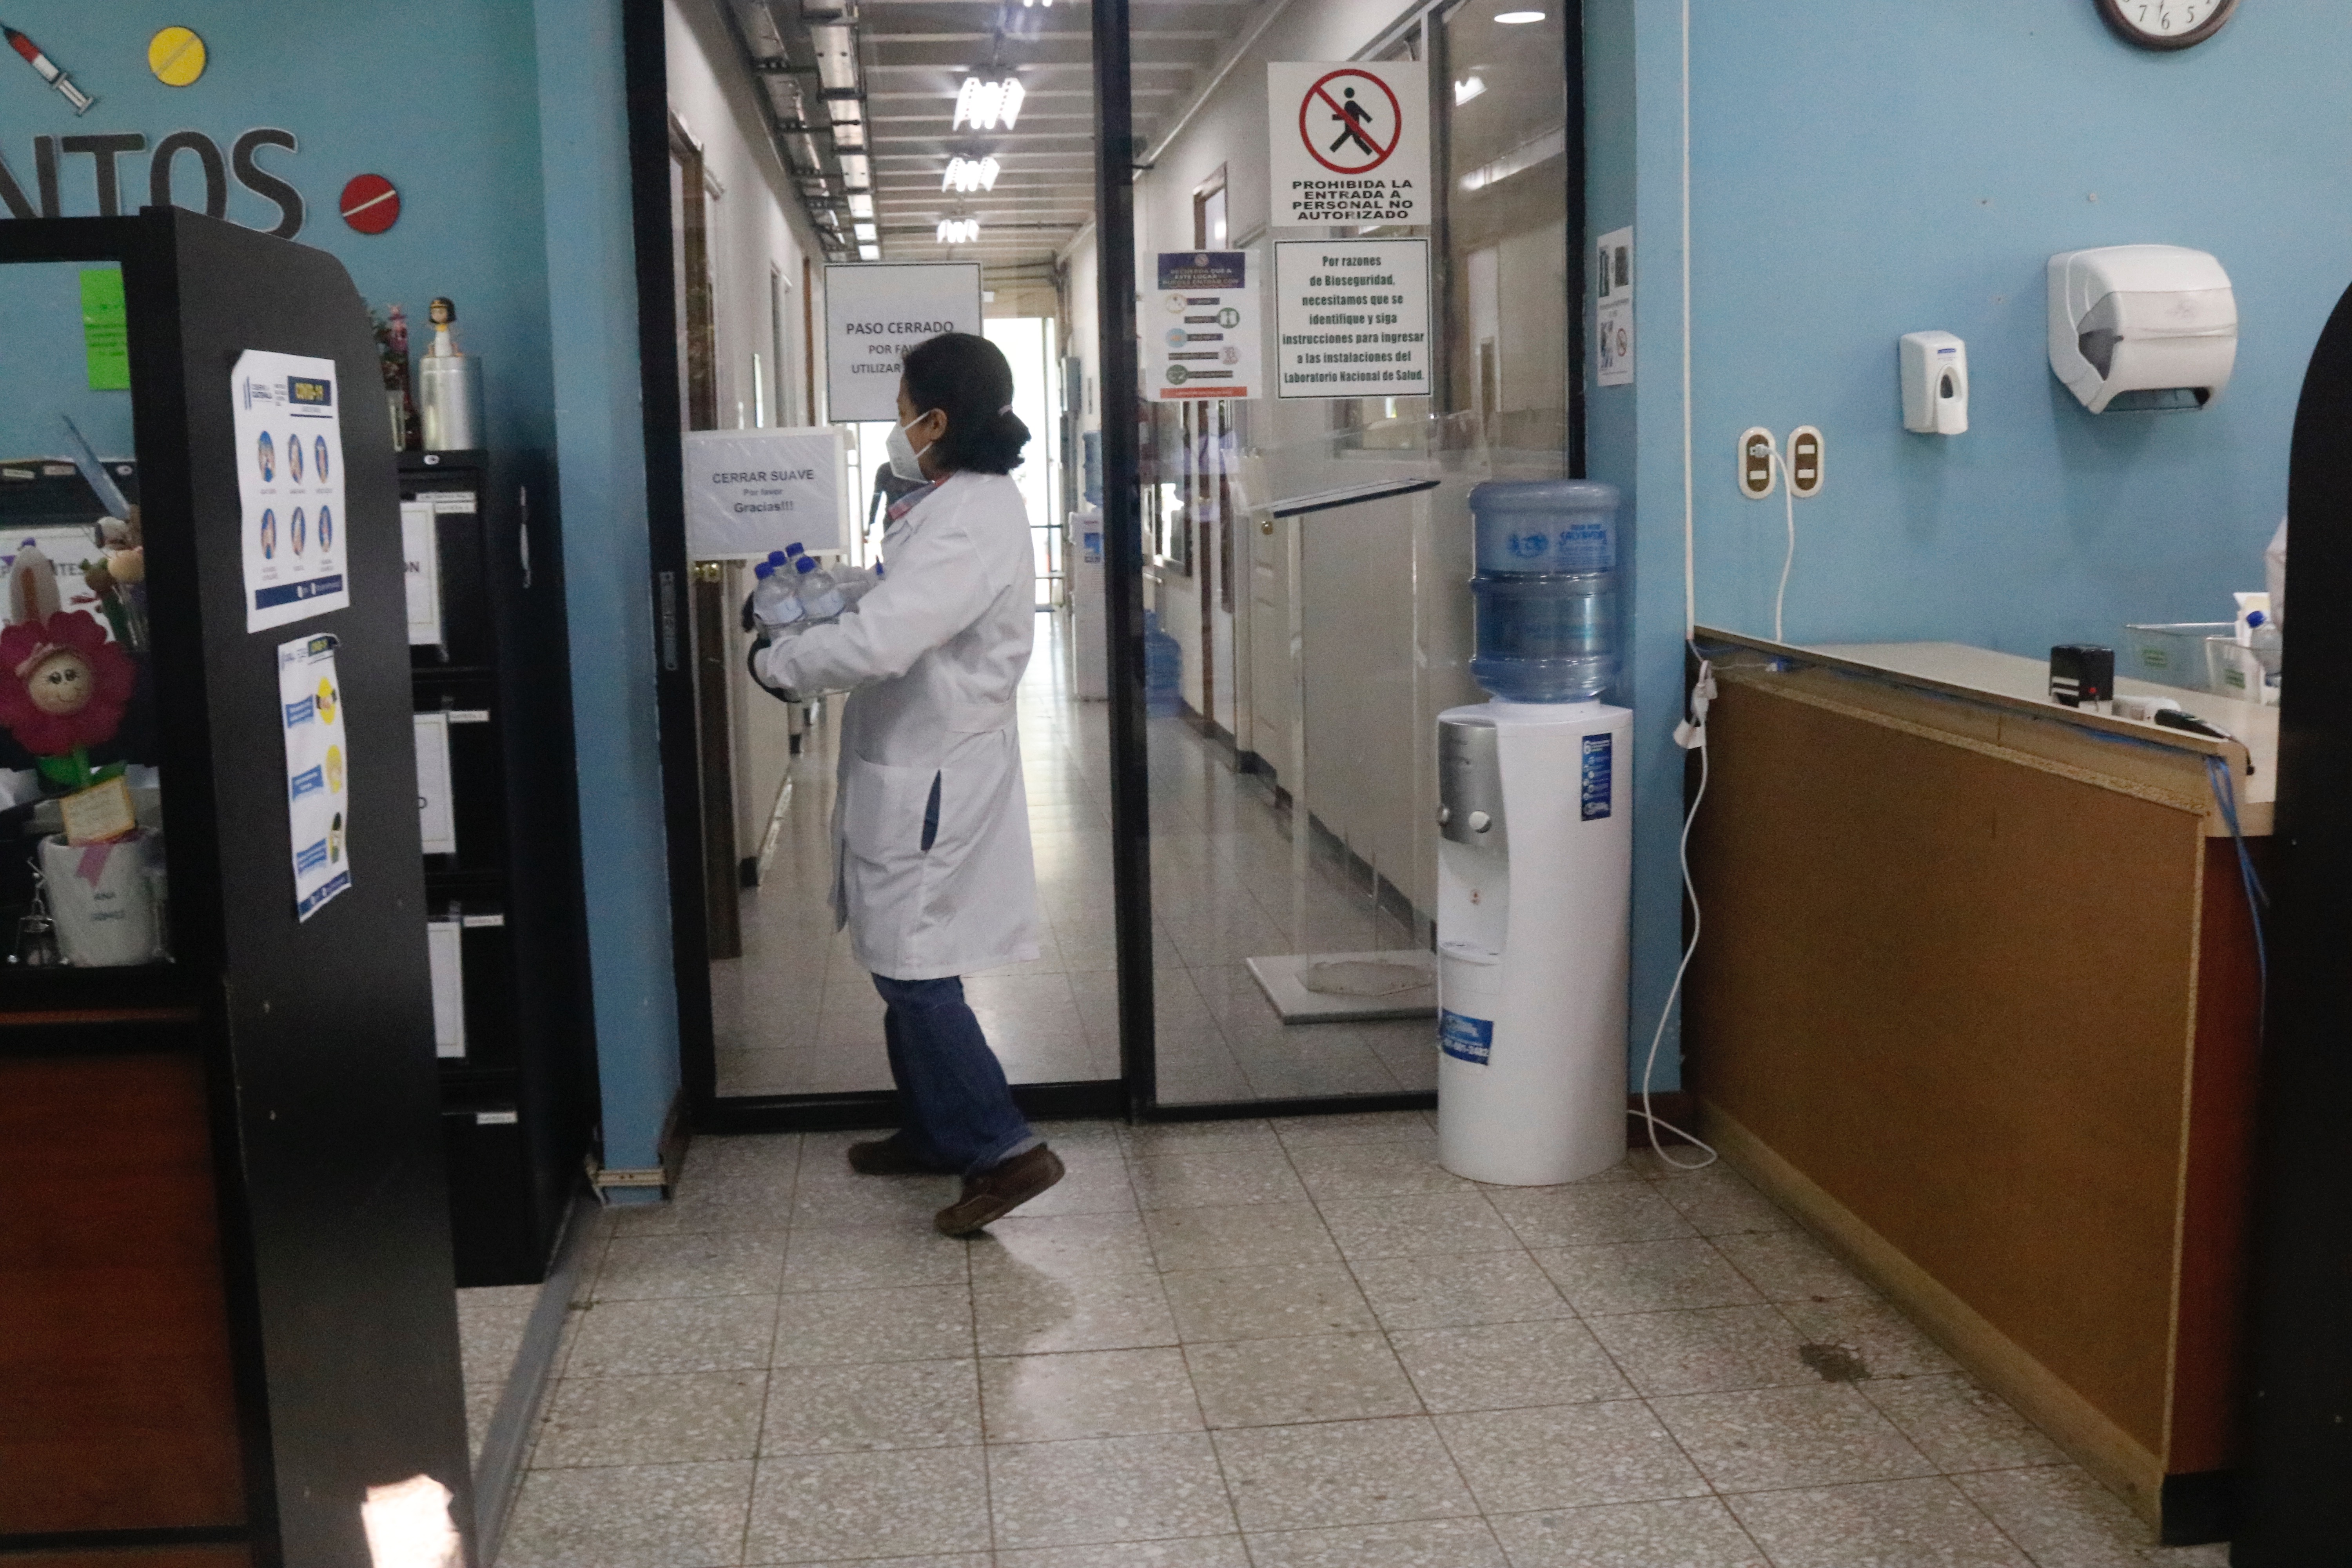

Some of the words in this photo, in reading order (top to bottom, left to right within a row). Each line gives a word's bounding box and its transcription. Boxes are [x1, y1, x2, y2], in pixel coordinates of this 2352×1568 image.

[2139, 5, 2147, 22] 7
[2186, 5, 2194, 24] 5
[2161, 12, 2170, 30] 6
[1292, 180, 1385, 189] PROHIBIDA
[1392, 180, 1412, 188] LA
[1305, 191, 1384, 200] ENTRADA
[1390, 190, 1401, 198] A
[1293, 201, 1383, 210] PERSONAL
[1389, 200, 1413, 209] NO
[1298, 210, 1408, 220] AUTORIZADO
[1322, 256, 1339, 267] Por
[1342, 257, 1381, 266] razones
[1310, 276, 1322, 287] de
[1302, 295, 1368, 306] necesitamos
[1370, 296, 1389, 305] que
[1392, 295, 1403, 304] se
[1309, 314, 1365, 325] identifique
[1368, 315, 1373, 325] y
[1376, 313, 1397, 325] siga
[846, 323, 883, 334] PASO
[888, 321, 953, 334] CERRADO
[1283, 334, 1353, 345] instrucciones
[1356, 334, 1379, 344] para
[1381, 333, 1424, 344] ingresar
[869, 345, 892, 354] POR
[1297, 355, 1303, 364] a
[1305, 353, 1321, 363] las
[1323, 352, 1393, 363] instalaciones
[1395, 351, 1411, 362] del
[852, 363, 901, 374] UTILIZAR
[1285, 372, 1338, 383] Laboratorio
[1340, 371, 1380, 382] Nacional
[1383, 371, 1394, 381] de
[712, 472, 766, 483] CERRAR
[771, 470, 814, 481] SUAVE
[734, 501, 793, 512] Gracias!!!
